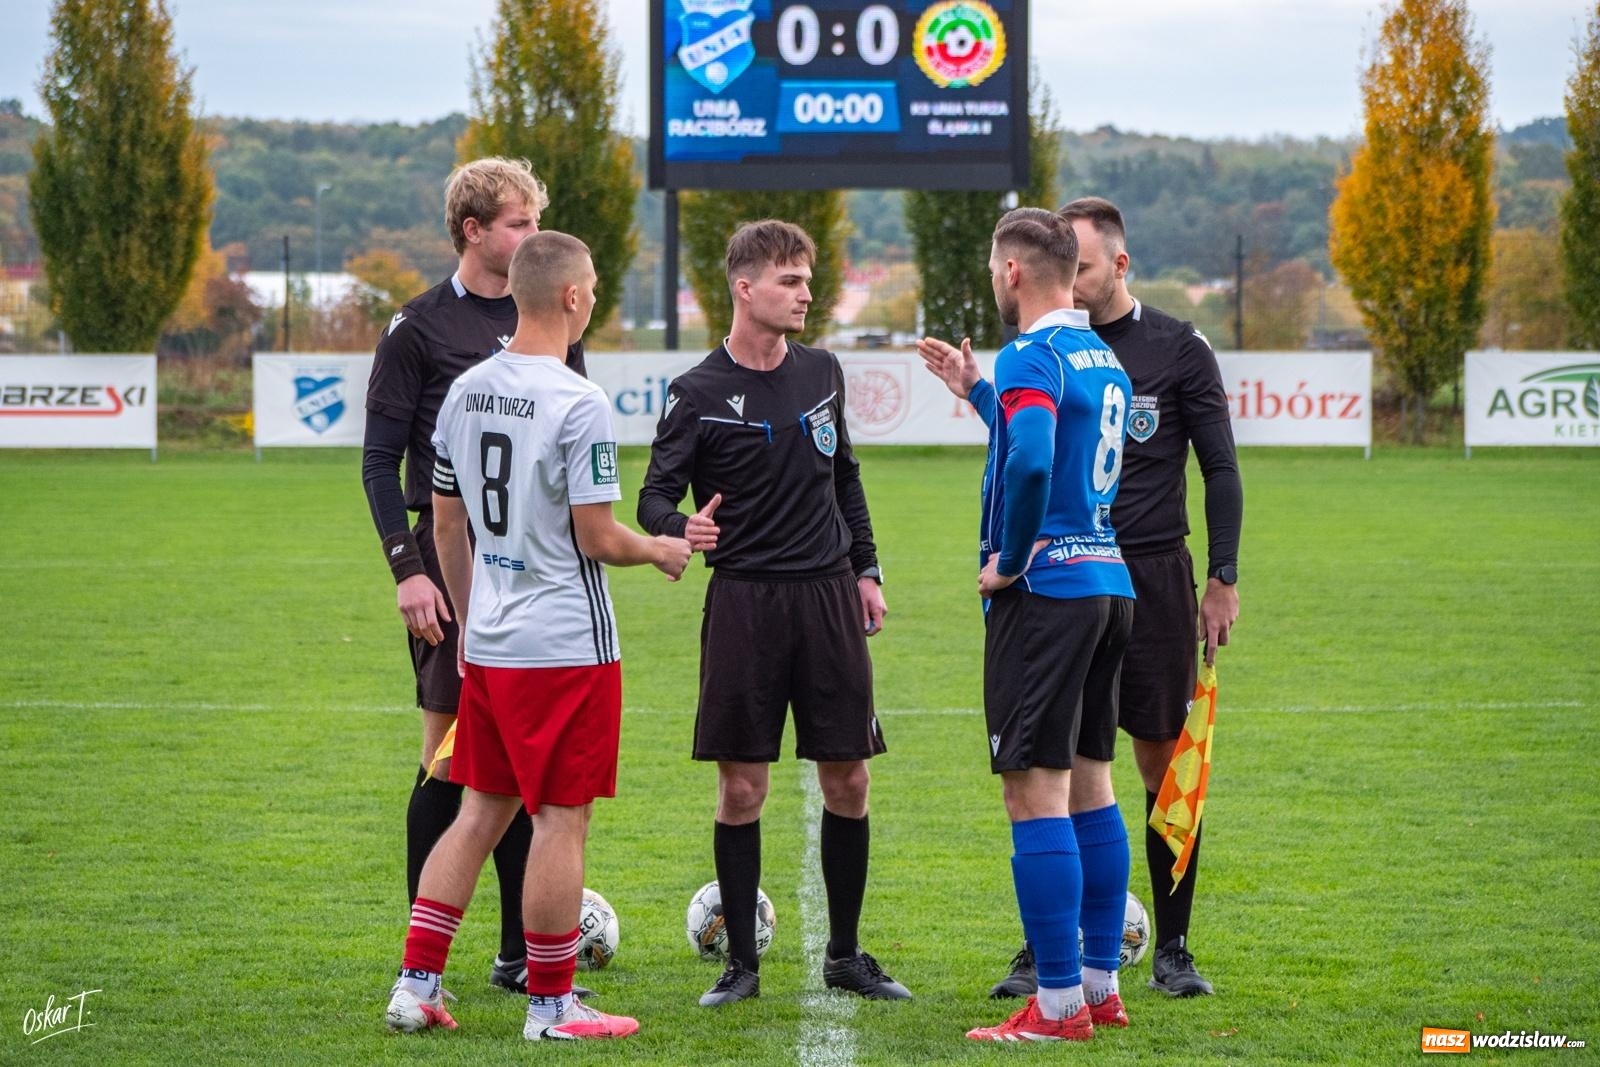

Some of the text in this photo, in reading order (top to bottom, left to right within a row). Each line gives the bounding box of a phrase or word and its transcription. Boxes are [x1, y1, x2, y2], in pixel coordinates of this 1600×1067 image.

[794, 92, 884, 124] 00:00
[667, 118, 768, 138] RACIBÓRZ
[465, 393, 535, 420] UNIA TURZA
[1093, 382, 1126, 496] 8
[480, 431, 513, 537] 8
